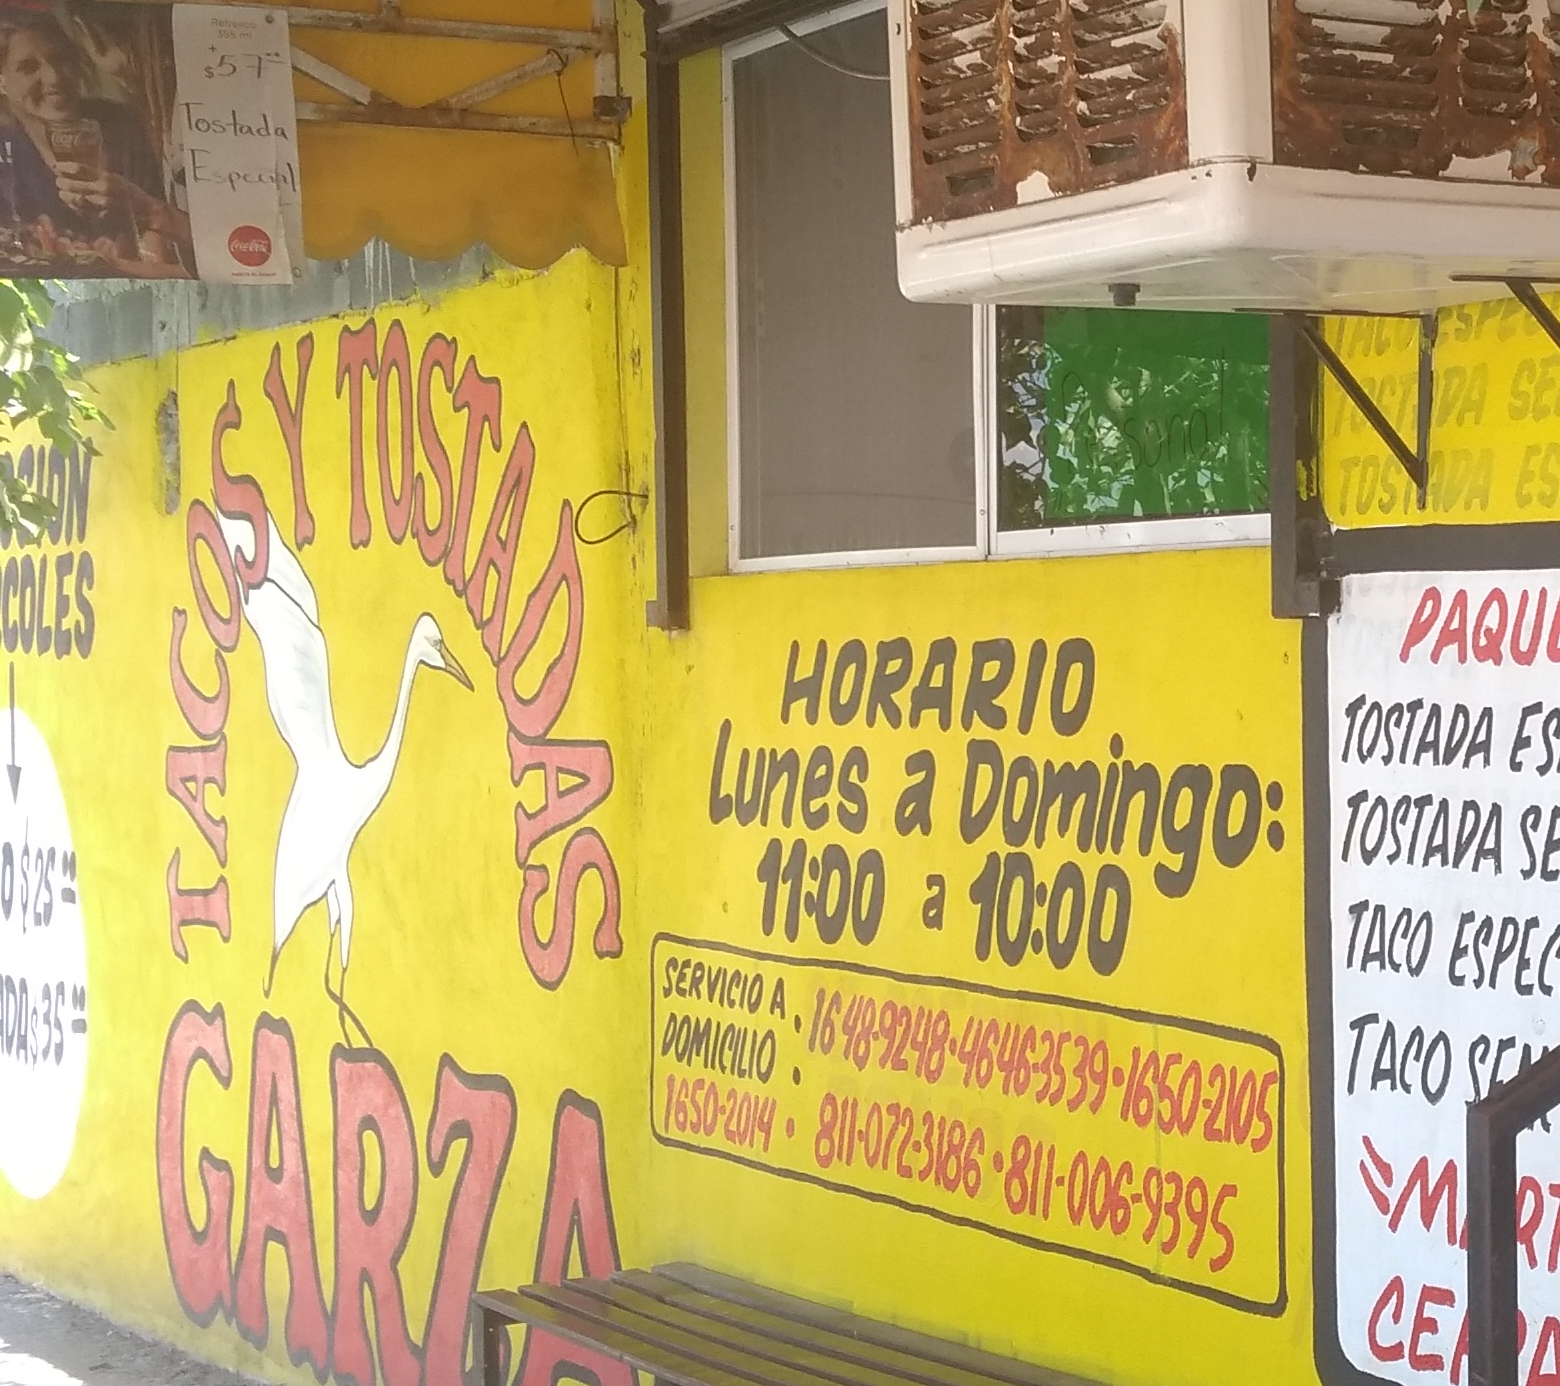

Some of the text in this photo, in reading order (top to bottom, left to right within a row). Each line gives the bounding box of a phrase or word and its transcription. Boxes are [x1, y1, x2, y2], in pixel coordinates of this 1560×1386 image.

[180, 102, 288, 140] Tostada
[263, 331, 314, 551] Y
[335, 316, 624, 992] TOSTADAS
[780, 637, 1096, 737] HORARIO
[1341, 693, 1493, 770] TOSTADA
[709, 718, 1286, 898] Lunes a Domingo:
[1341, 789, 1502, 877] TOSTADA
[756, 838, 1132, 977] 11:00 a 10:00
[1346, 899, 1433, 978] TACO
[662, 957, 786, 1020] SERVICIO A
[660, 1012, 777, 1085] DOMICILIO
[1346, 1013, 1452, 1107] TACO
[664, 1073, 777, 1154] 1650-2014
